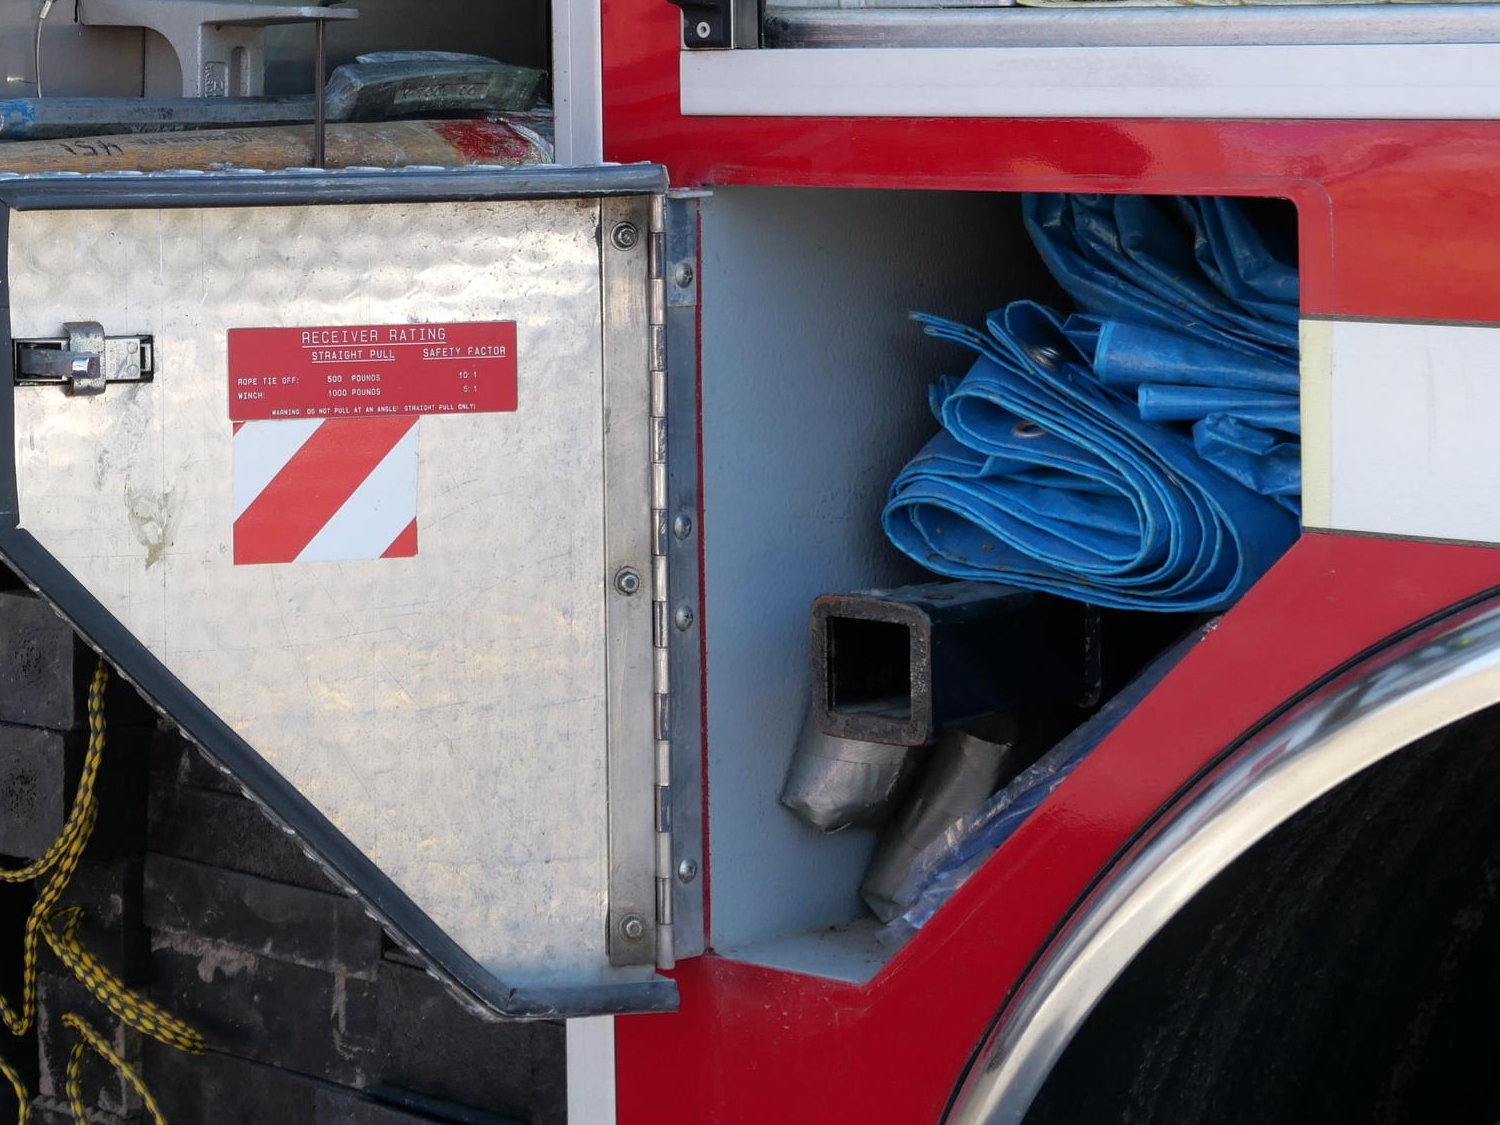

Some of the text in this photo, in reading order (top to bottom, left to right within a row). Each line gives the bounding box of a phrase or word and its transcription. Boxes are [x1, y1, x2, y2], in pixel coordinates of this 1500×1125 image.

[302, 327, 447, 344] RECEIVER RATING
[311, 348, 396, 361] STRAIGHT PULL
[423, 346, 507, 358] SAFETY FACTOR
[237, 376, 300, 386] ROPE TIE OFF:
[327, 373, 381, 383] 500 POUNDS
[237, 392, 266, 400] WINCH:
[328, 388, 381, 397] 1000 POUNDS
[307, 407, 316, 415] DO
[334, 406, 349, 414] PULL
[403, 404, 435, 412] STRAIGHT
